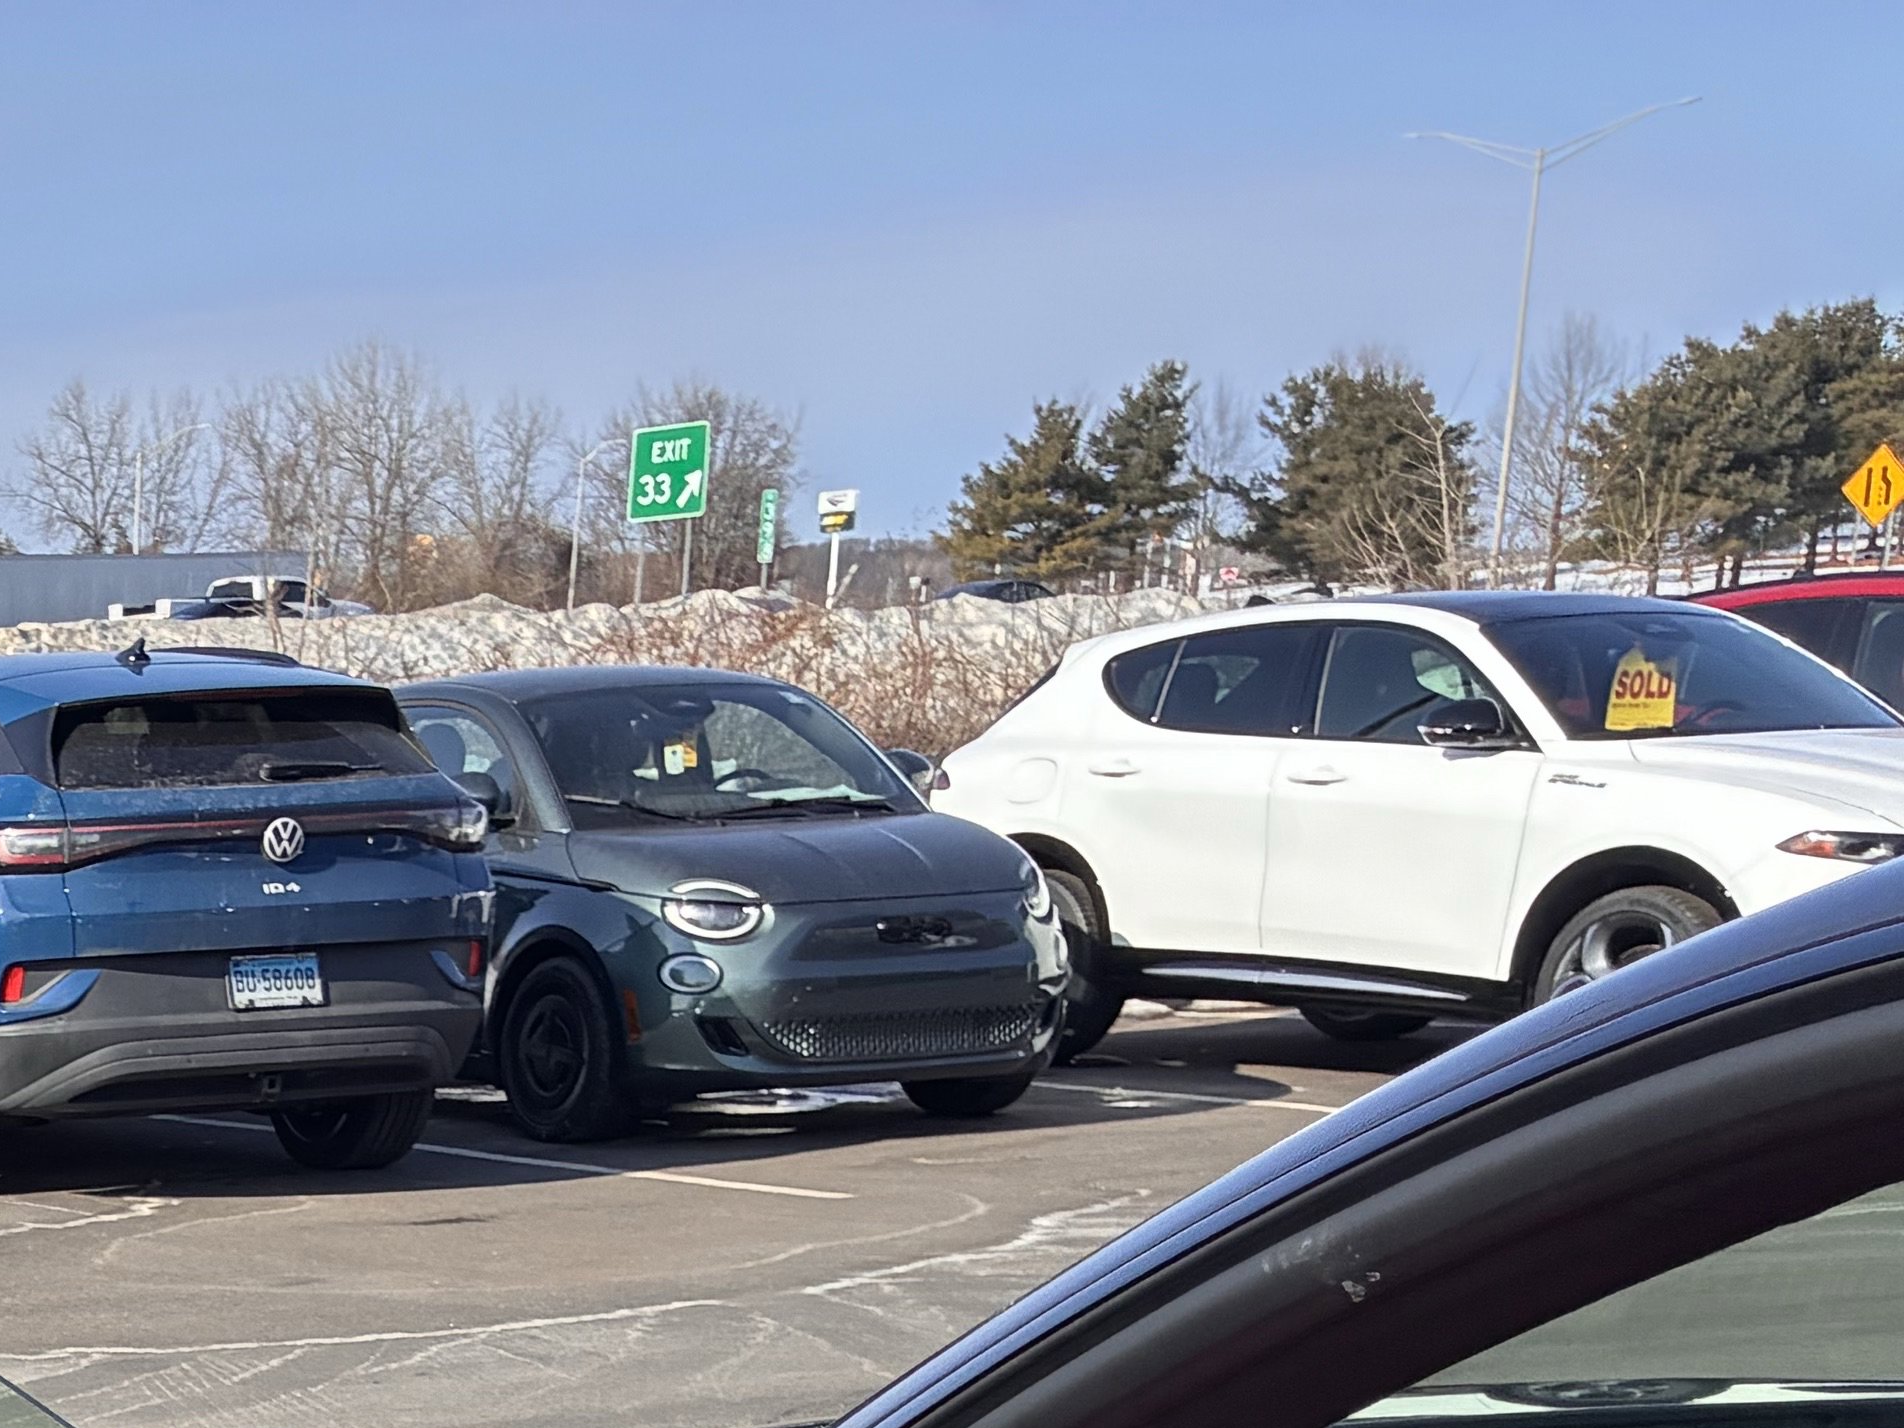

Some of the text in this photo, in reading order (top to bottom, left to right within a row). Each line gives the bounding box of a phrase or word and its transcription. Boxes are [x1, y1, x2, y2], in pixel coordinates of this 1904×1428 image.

[651, 437, 692, 464] EXIT
[636, 472, 672, 506] 33
[1615, 669, 1672, 700] SOLD
